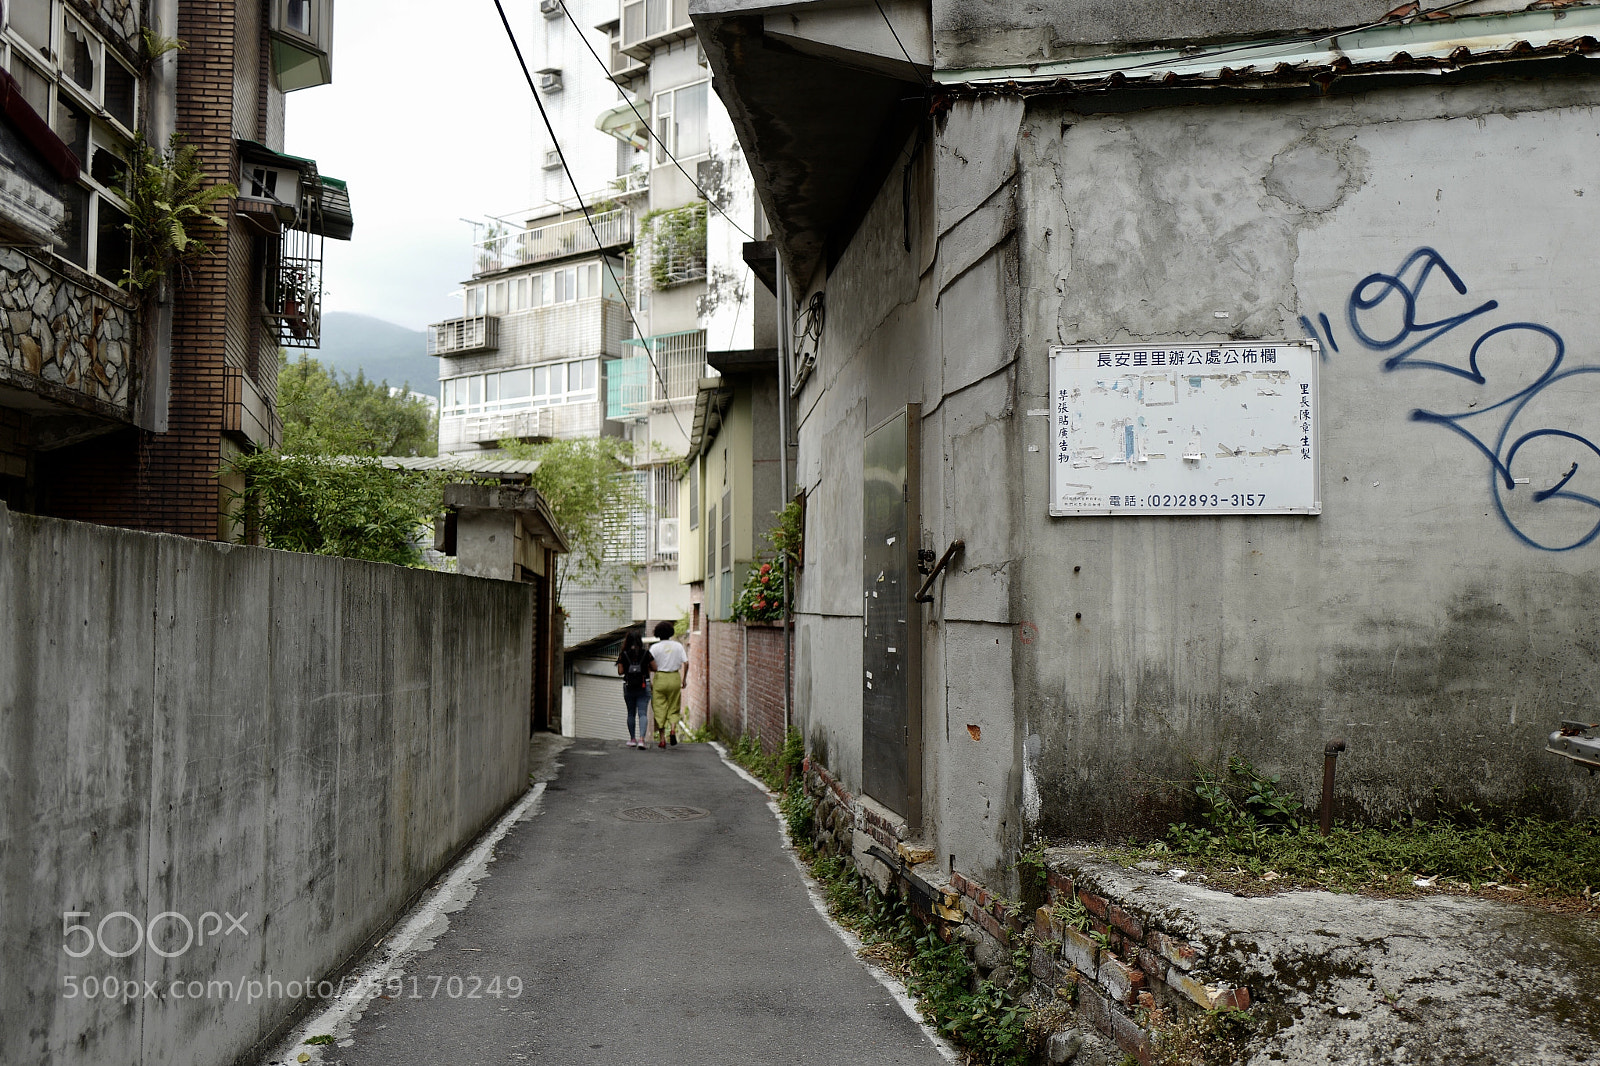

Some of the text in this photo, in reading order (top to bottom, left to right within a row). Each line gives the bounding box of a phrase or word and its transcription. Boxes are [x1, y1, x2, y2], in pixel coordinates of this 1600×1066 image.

[1097, 349, 1277, 368] 長安里里辦公處公佈欄
